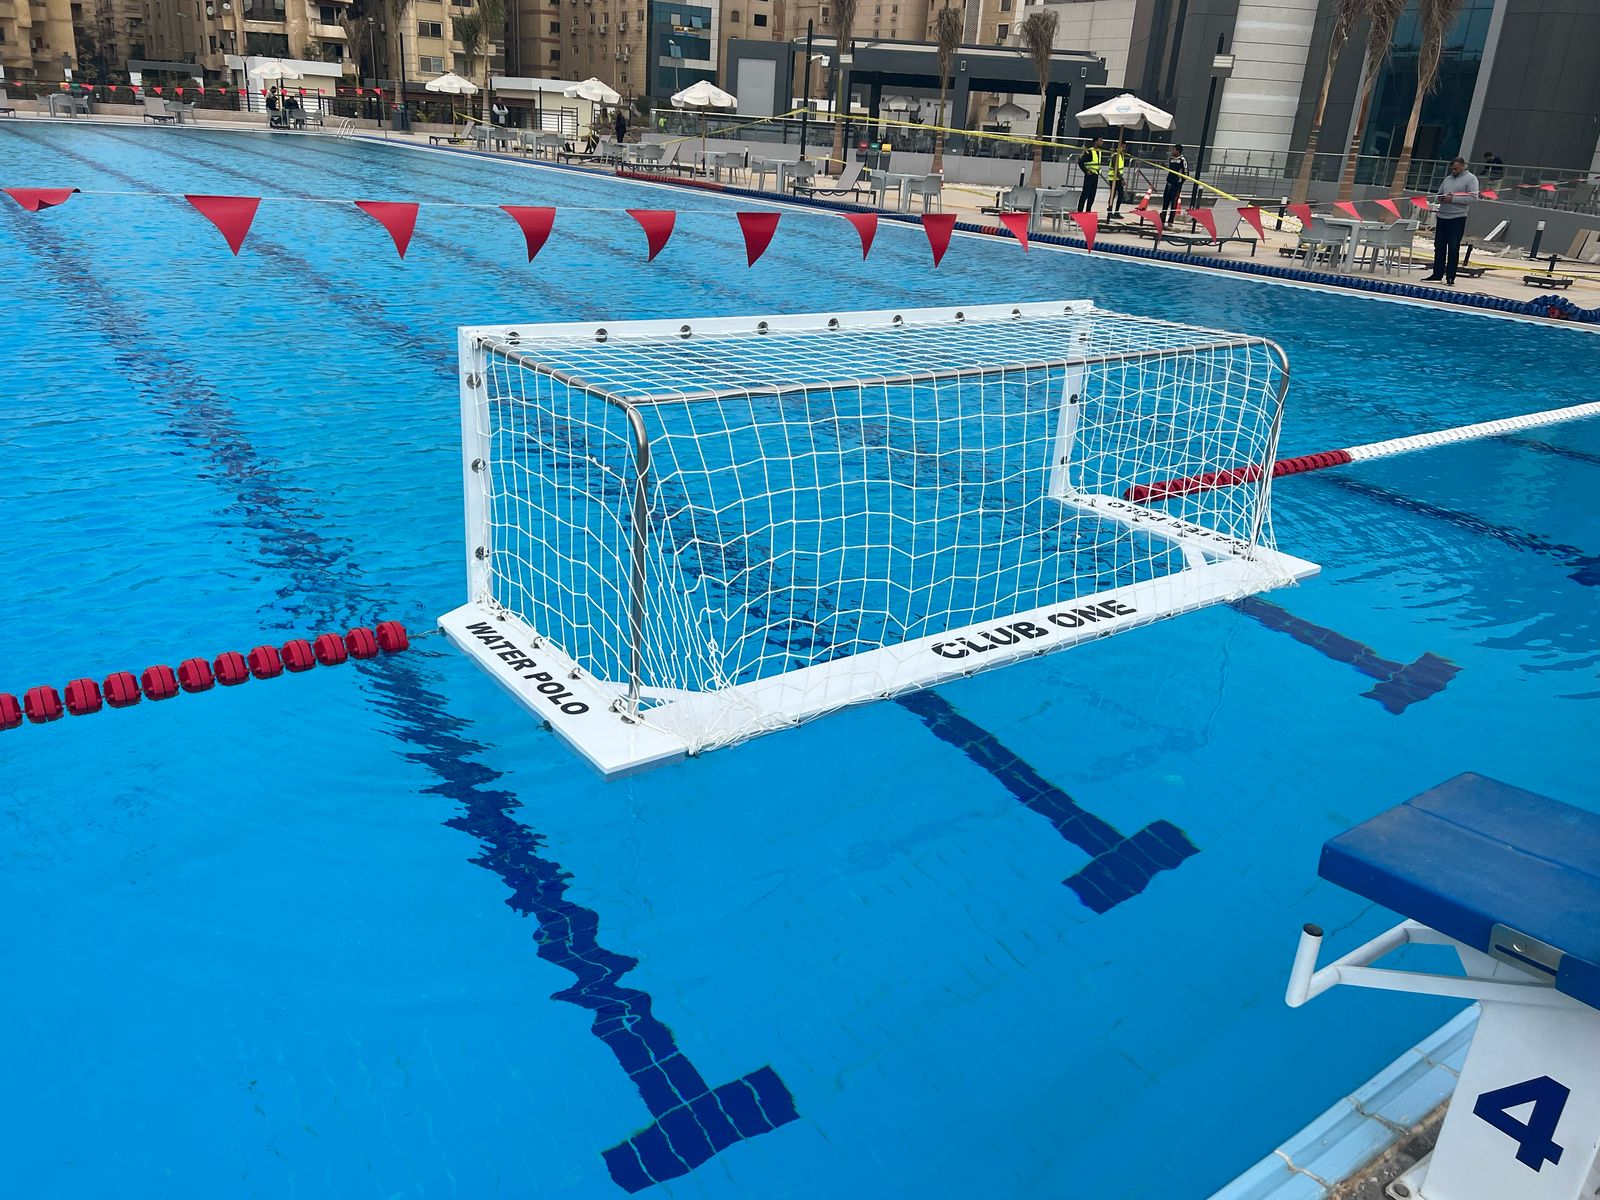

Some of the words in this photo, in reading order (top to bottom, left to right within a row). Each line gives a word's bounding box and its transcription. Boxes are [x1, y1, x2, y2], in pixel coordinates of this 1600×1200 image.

[464, 621, 537, 672] WATER
[523, 671, 590, 715] POLO
[931, 621, 1049, 659] CLUB
[1047, 599, 1137, 628] ONE
[1472, 1075, 1571, 1173] 4
